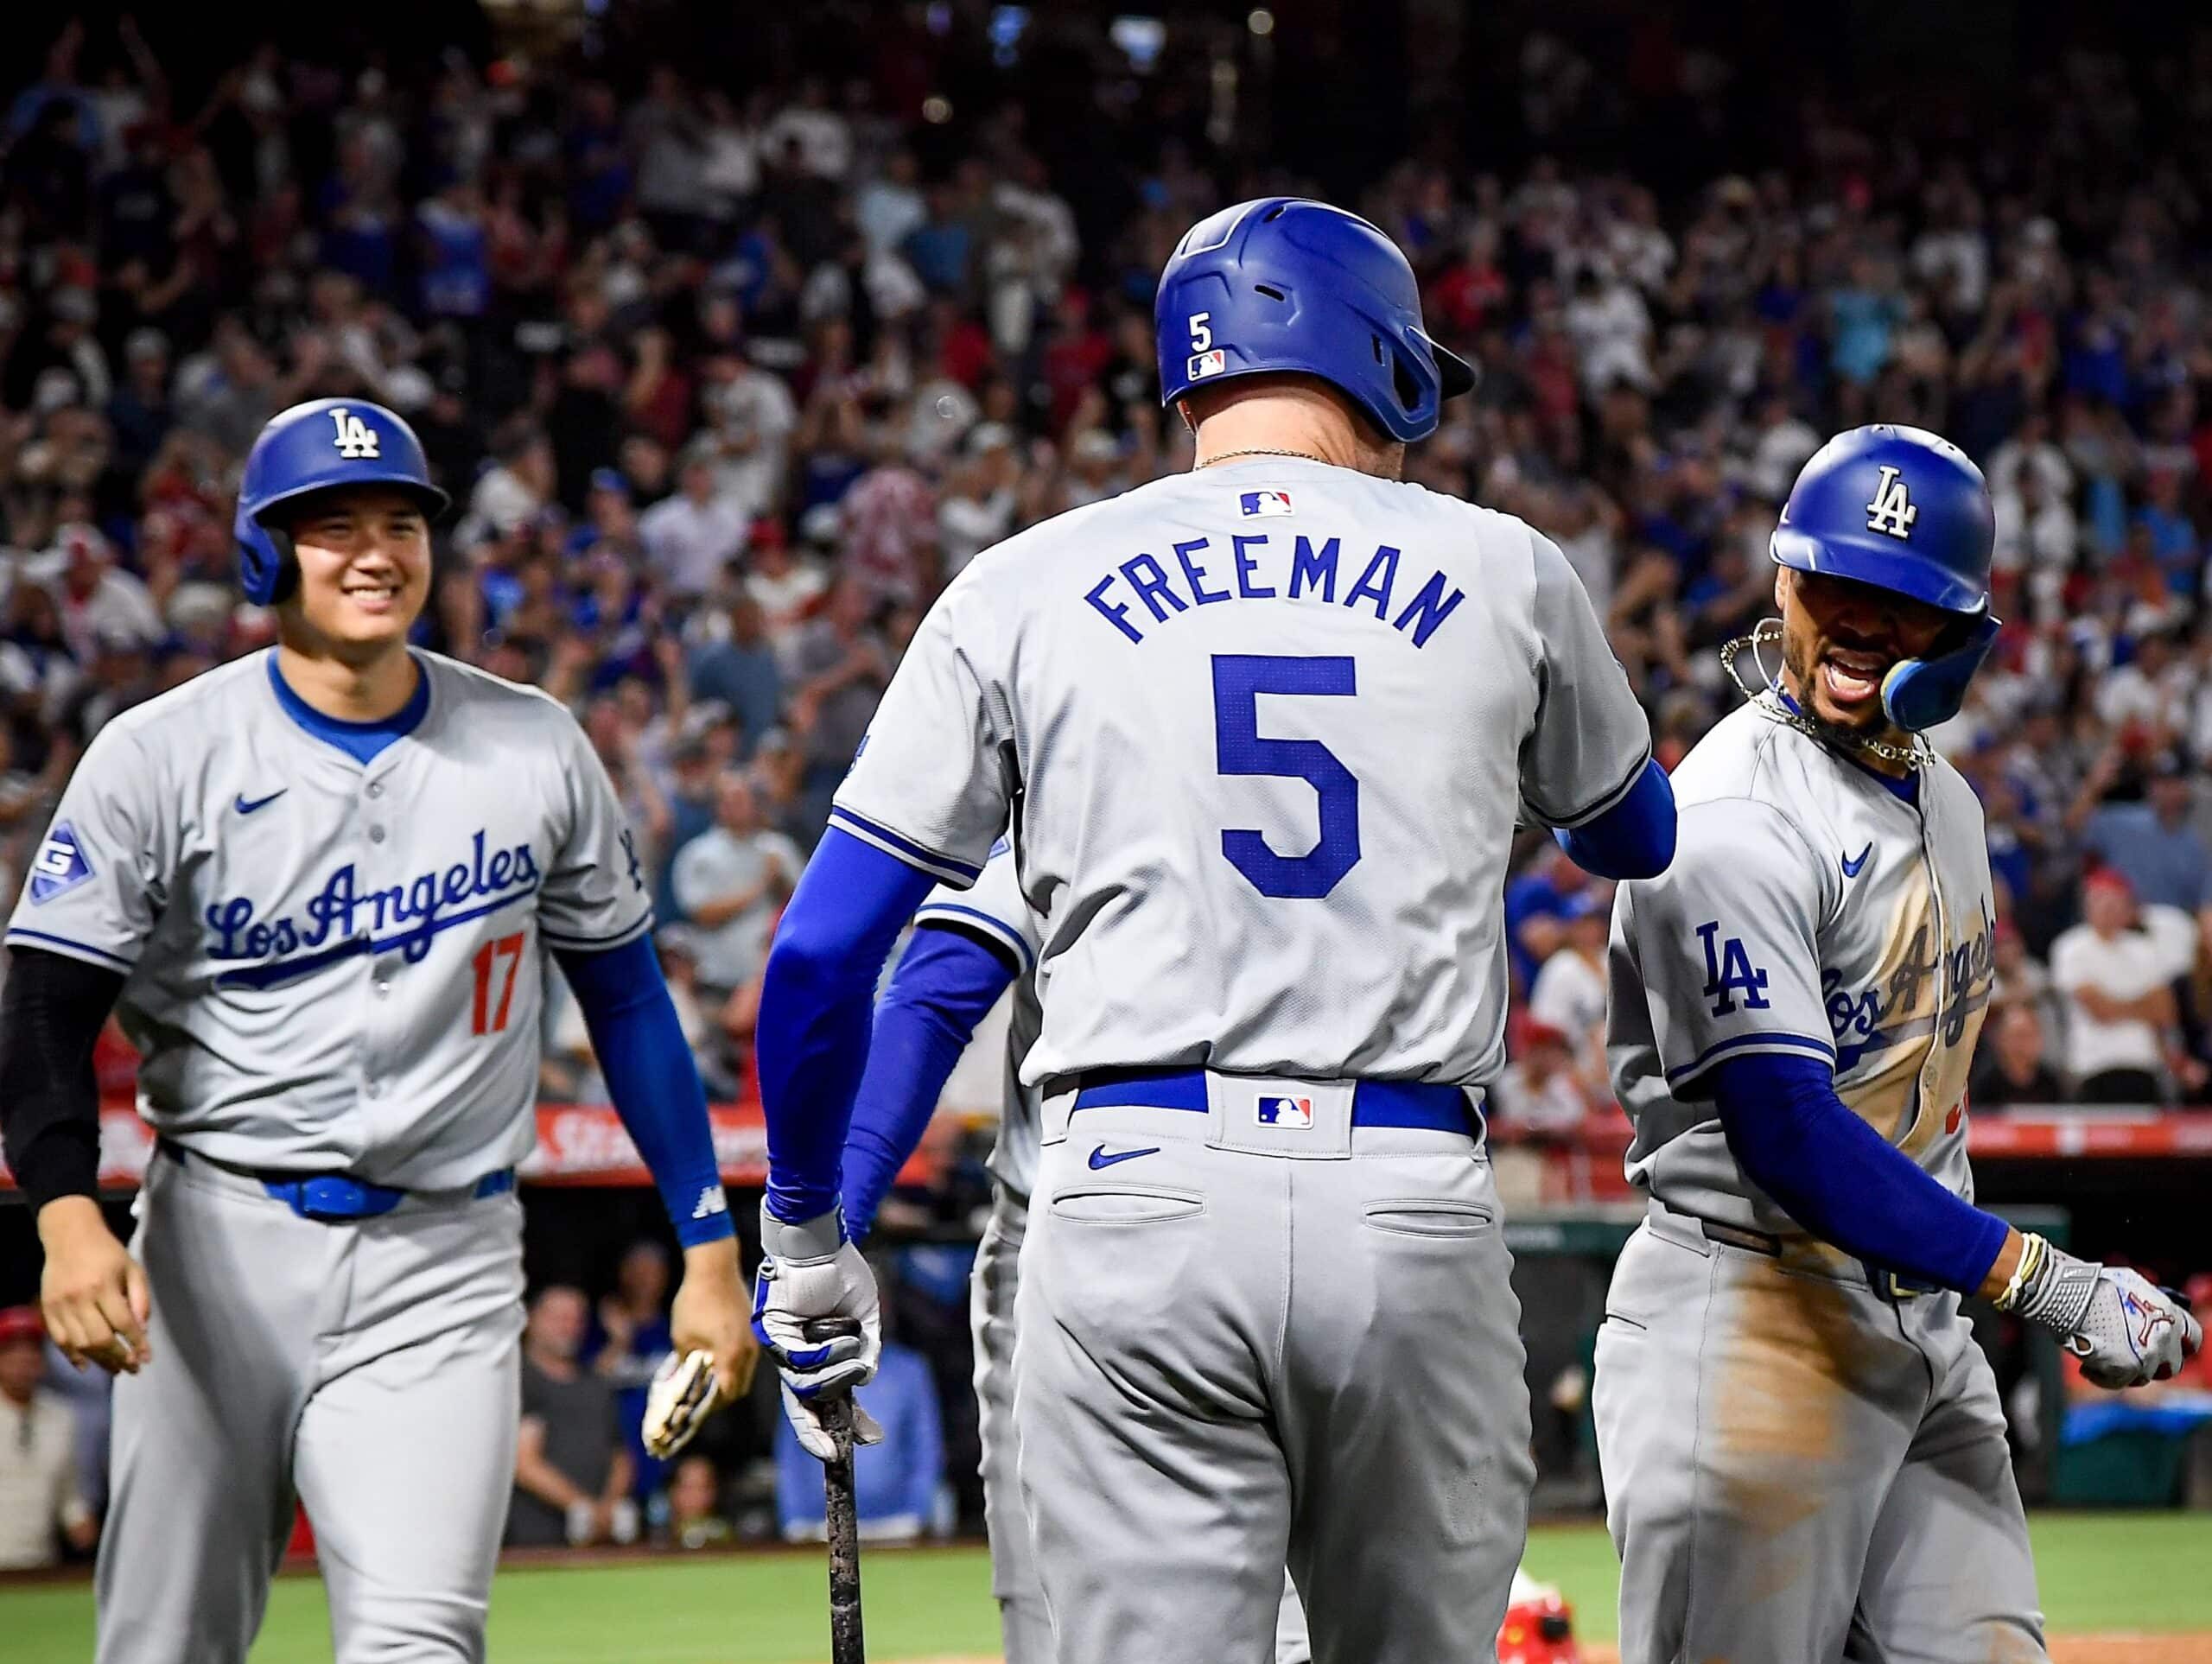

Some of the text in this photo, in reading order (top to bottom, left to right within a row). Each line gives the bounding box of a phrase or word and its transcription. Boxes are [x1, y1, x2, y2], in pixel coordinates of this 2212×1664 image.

[1189, 311, 1212, 352] 5
[327, 407, 381, 459] LA
[1866, 465, 1917, 539] LA
[1083, 534, 1466, 649] FREEMAN
[1211, 653, 1363, 899] 5
[206, 897, 299, 961] Los
[302, 829, 540, 965] Angeles
[472, 930, 525, 1036] 17
[1695, 919, 1771, 1018] LA
